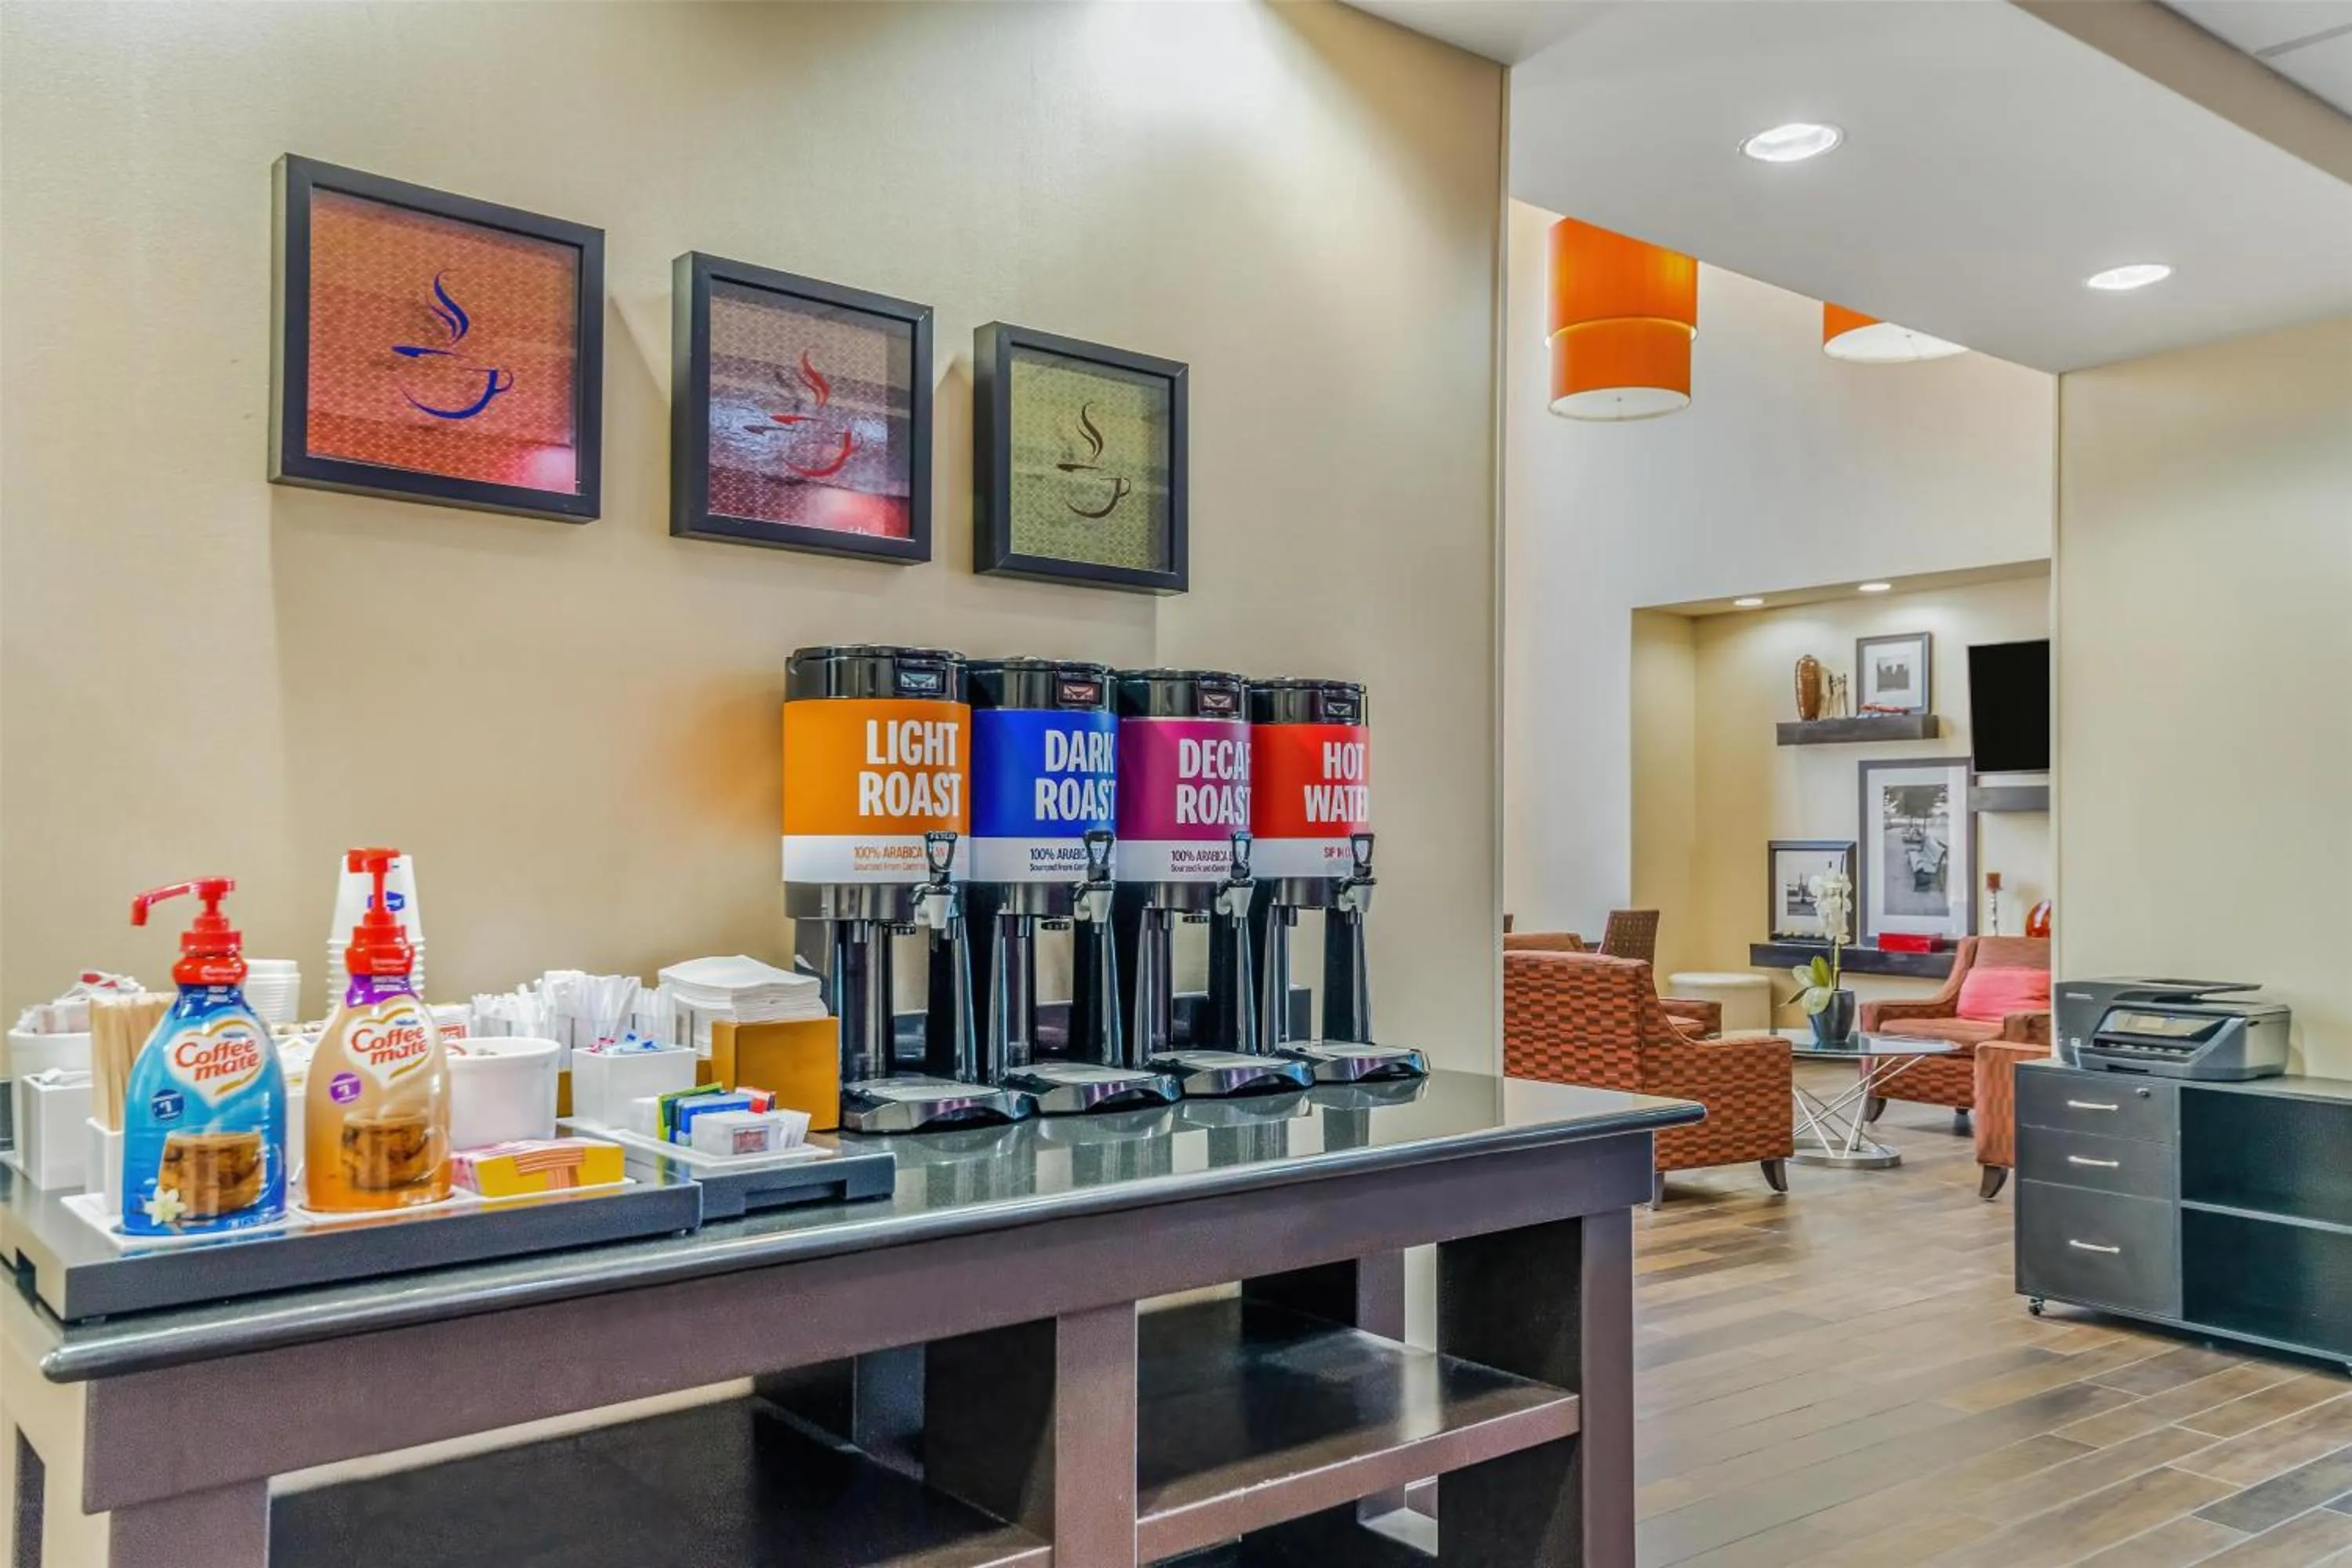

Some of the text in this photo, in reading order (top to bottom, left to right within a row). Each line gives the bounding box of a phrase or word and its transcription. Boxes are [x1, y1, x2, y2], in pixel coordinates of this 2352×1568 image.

[866, 719, 959, 766] LIGHT
[1045, 729, 1115, 773] DARK
[1323, 742, 1365, 781] HOT
[858, 771, 963, 817] ROAST
[1036, 778, 1116, 821] ROAST
[1176, 784, 1251, 826] ROAST
[1304, 785, 1369, 822] WATE
[855, 846, 880, 858] 100%
[884, 844, 924, 858] ARABICA
[1029, 848, 1087, 860] 100% ARABIC
[1171, 850, 1195, 862] 100%
[1196, 850, 1229, 862] ARABICA
[175, 1040, 256, 1068] Coffee
[350, 1027, 425, 1054] Coffee
[370, 1040, 428, 1065] mate
[194, 1052, 260, 1081] mate
